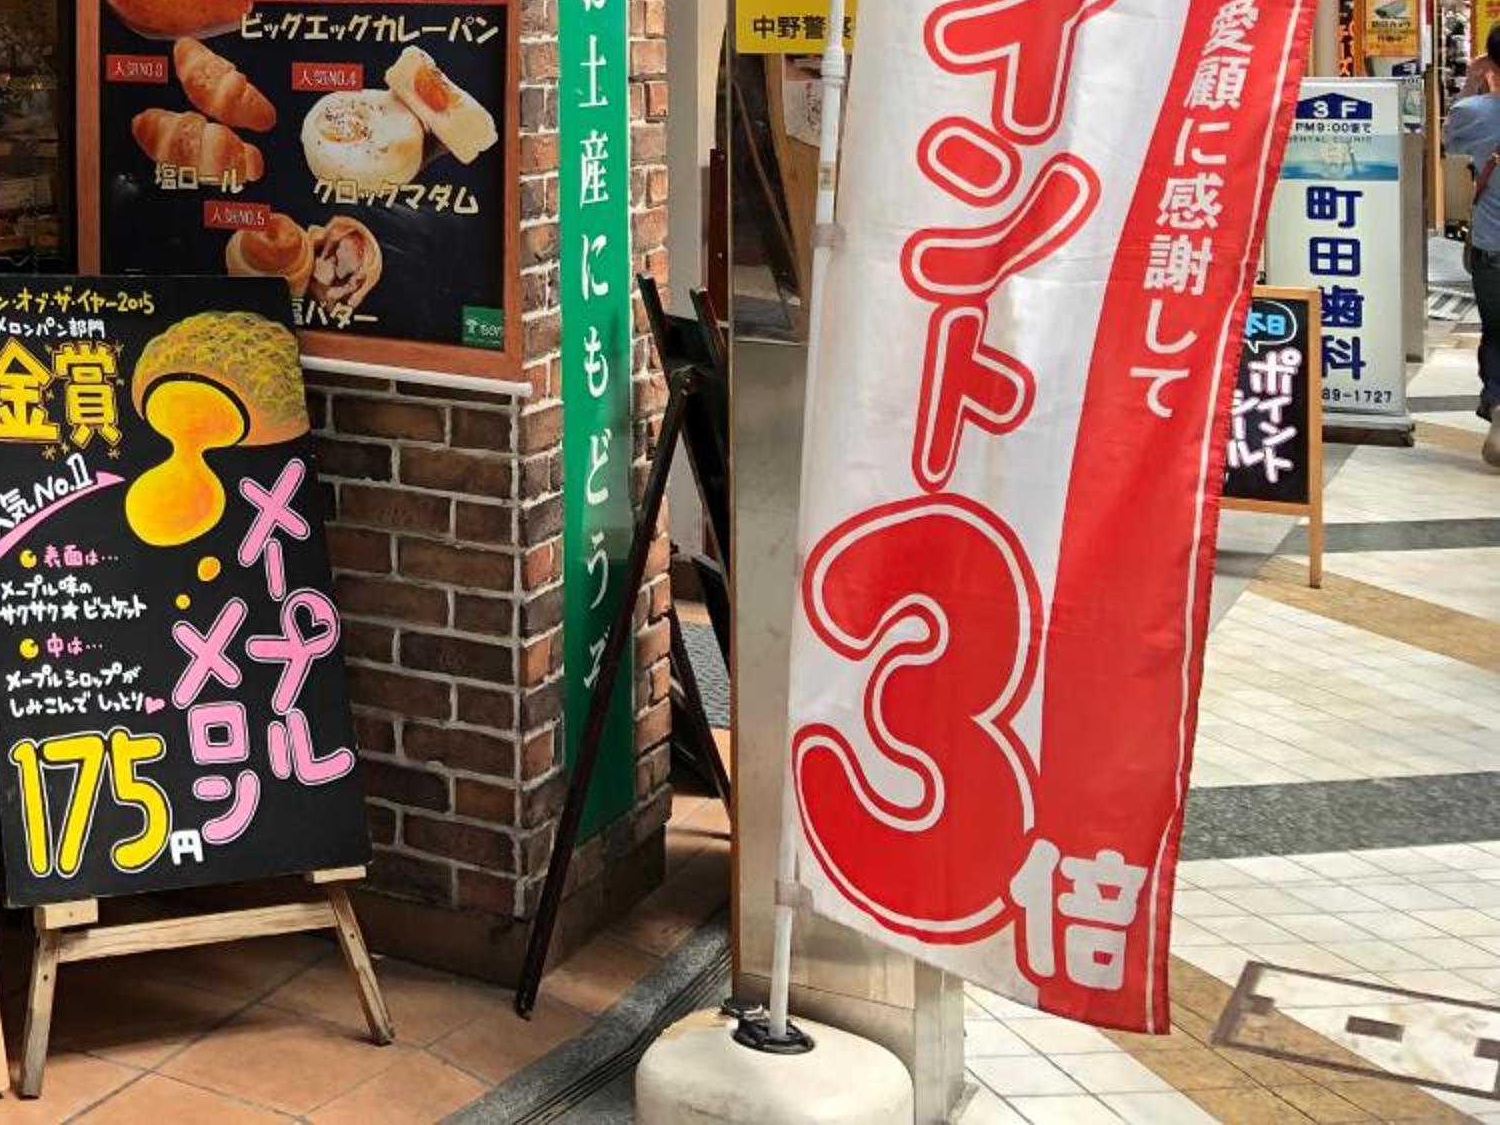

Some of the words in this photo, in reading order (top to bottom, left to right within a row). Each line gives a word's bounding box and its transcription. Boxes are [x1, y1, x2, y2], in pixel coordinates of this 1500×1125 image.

[240, 12, 499, 44] ビッグエッグカレーパン
[155, 163, 243, 195] 塩ロール
[312, 180, 480, 215] クロックマダム
[1304, 185, 1367, 381] 町田歯科
[1227, 388, 1265, 469] シール
[1247, 347, 1303, 484] ポイント
[0, 574, 92, 600] メープル味の
[237, 458, 356, 786] メープル
[6, 661, 143, 693] メープルシロップが
[171, 596, 261, 845] メロン
[9, 724, 204, 880] 175円
